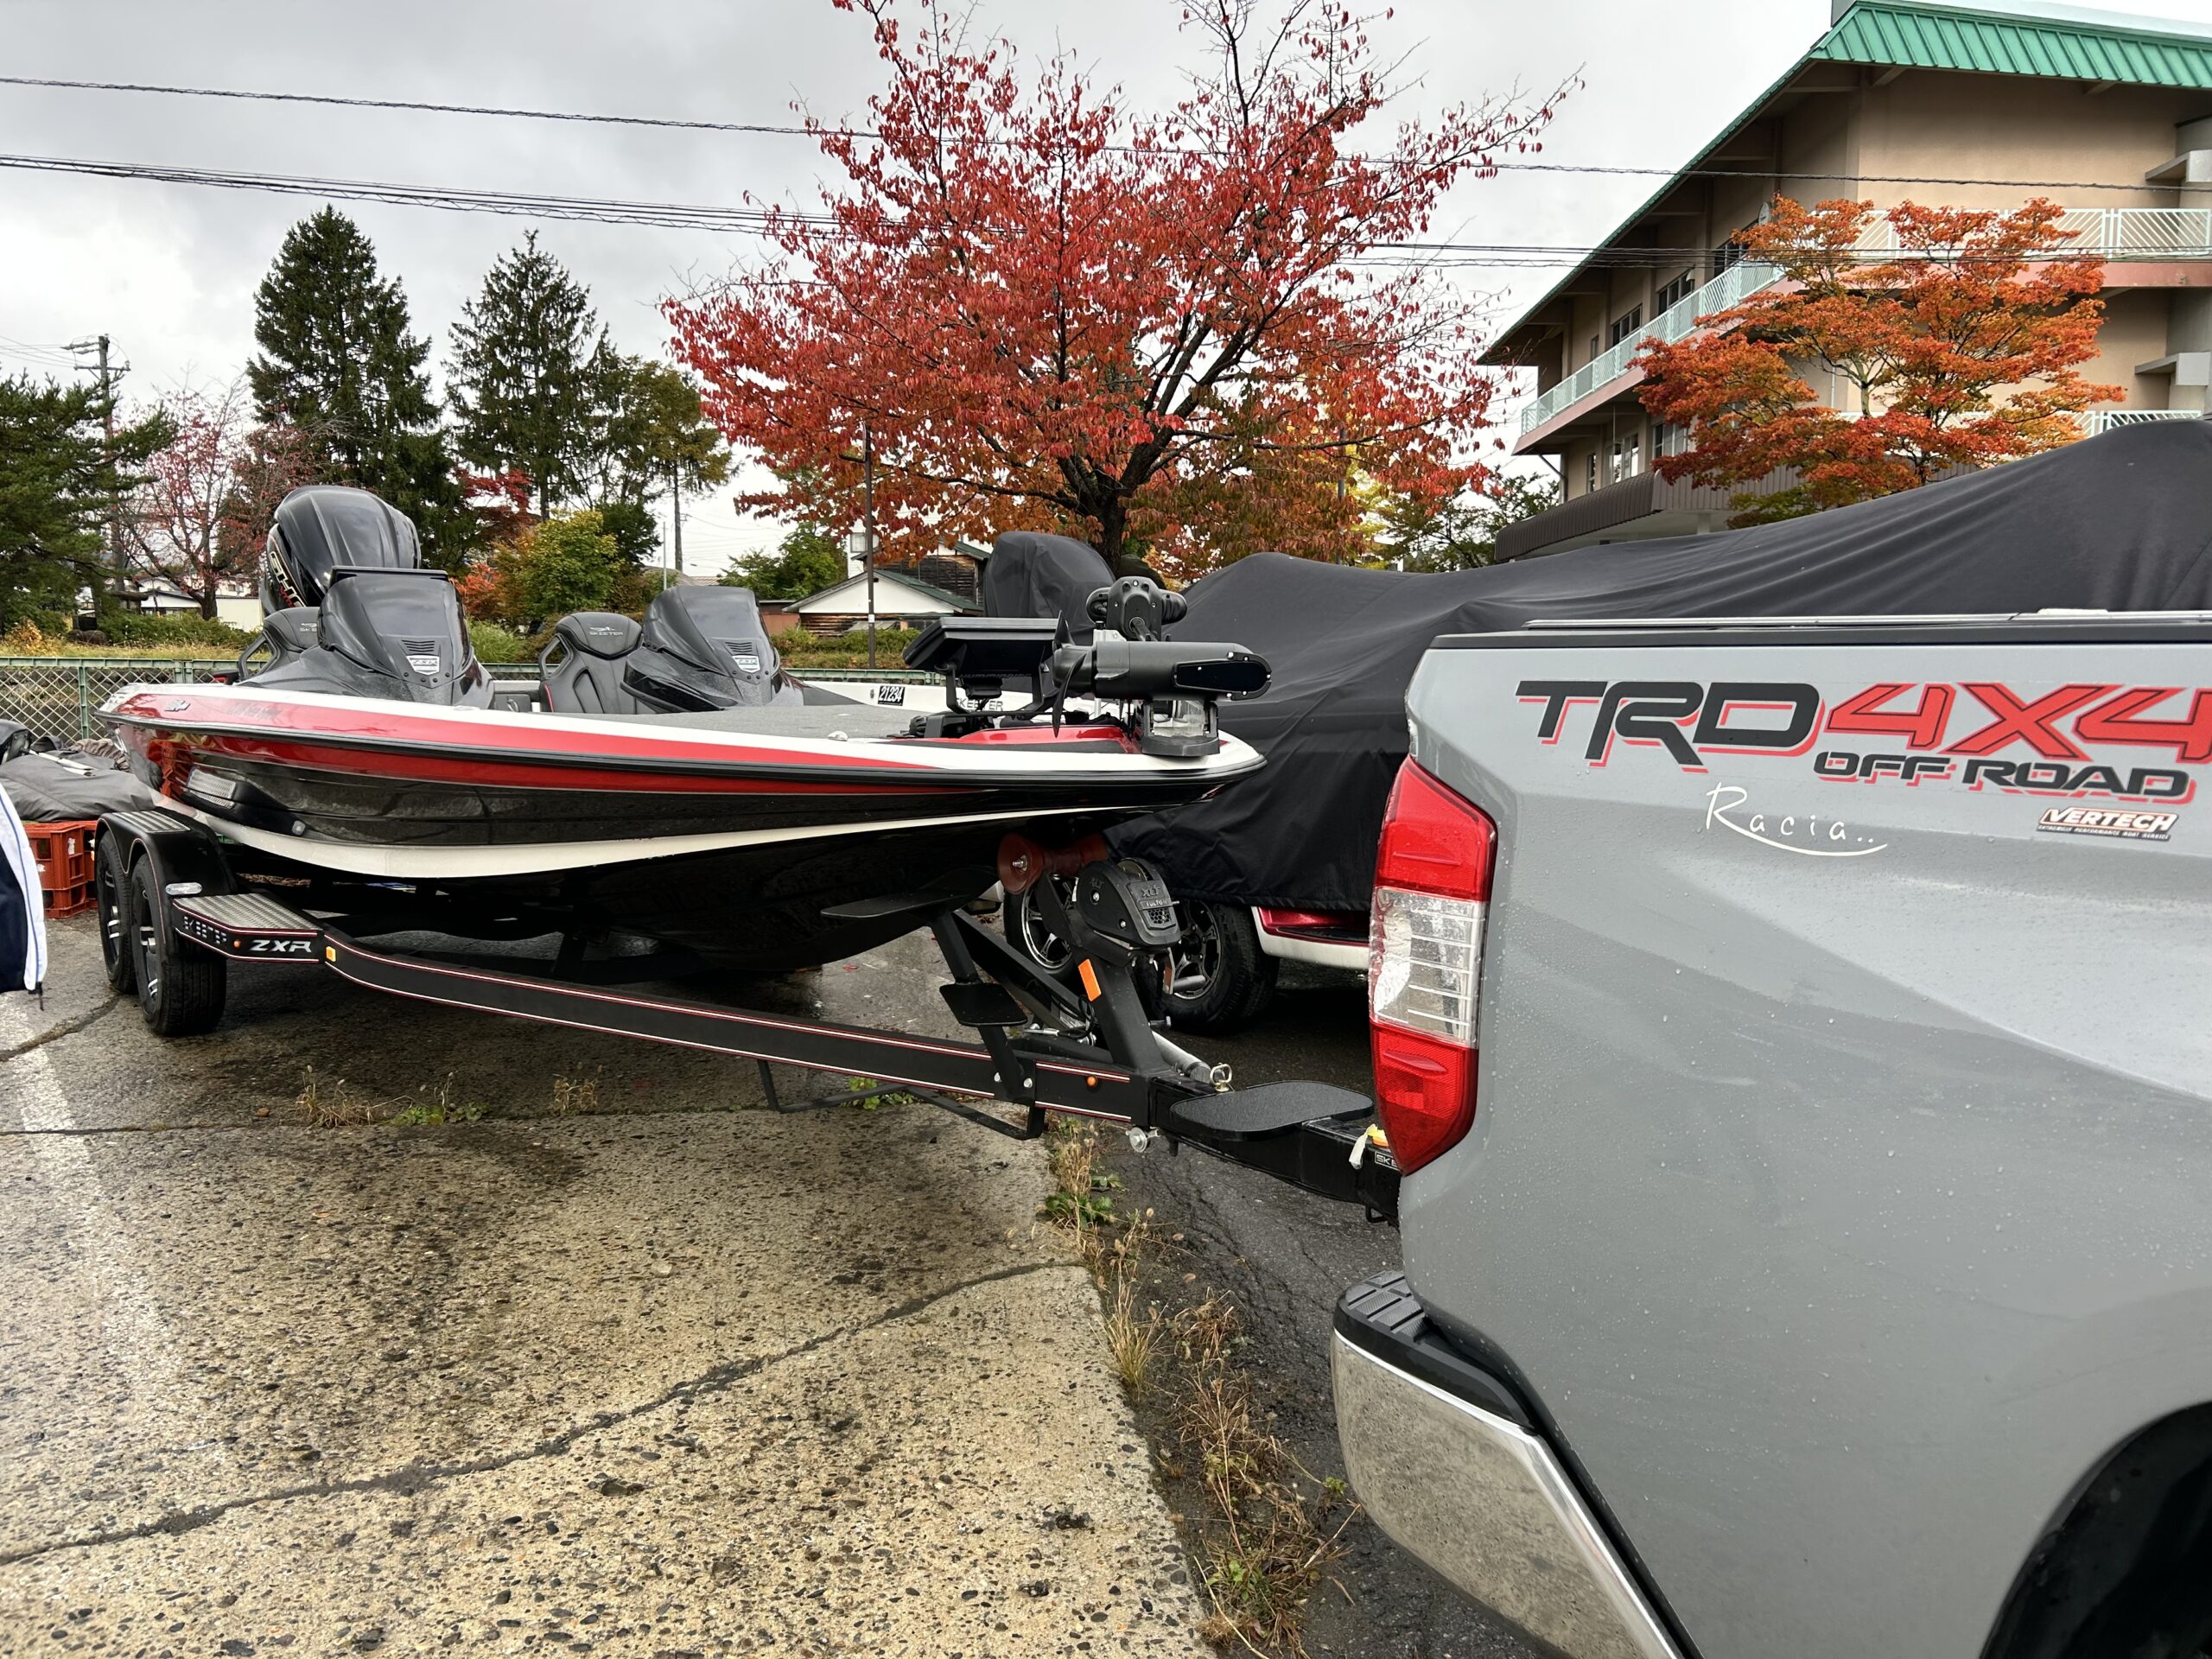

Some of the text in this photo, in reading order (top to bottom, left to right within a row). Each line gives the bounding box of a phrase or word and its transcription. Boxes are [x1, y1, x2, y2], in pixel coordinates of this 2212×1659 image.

[879, 686, 905, 702] 21234
[1515, 680, 2212, 774] TRD 4X4
[1813, 750, 2196, 805] OFF ROAD
[2043, 808, 2177, 833] VERTECH
[1140, 884, 1161, 898] XLT
[249, 939, 312, 953] ZXR
